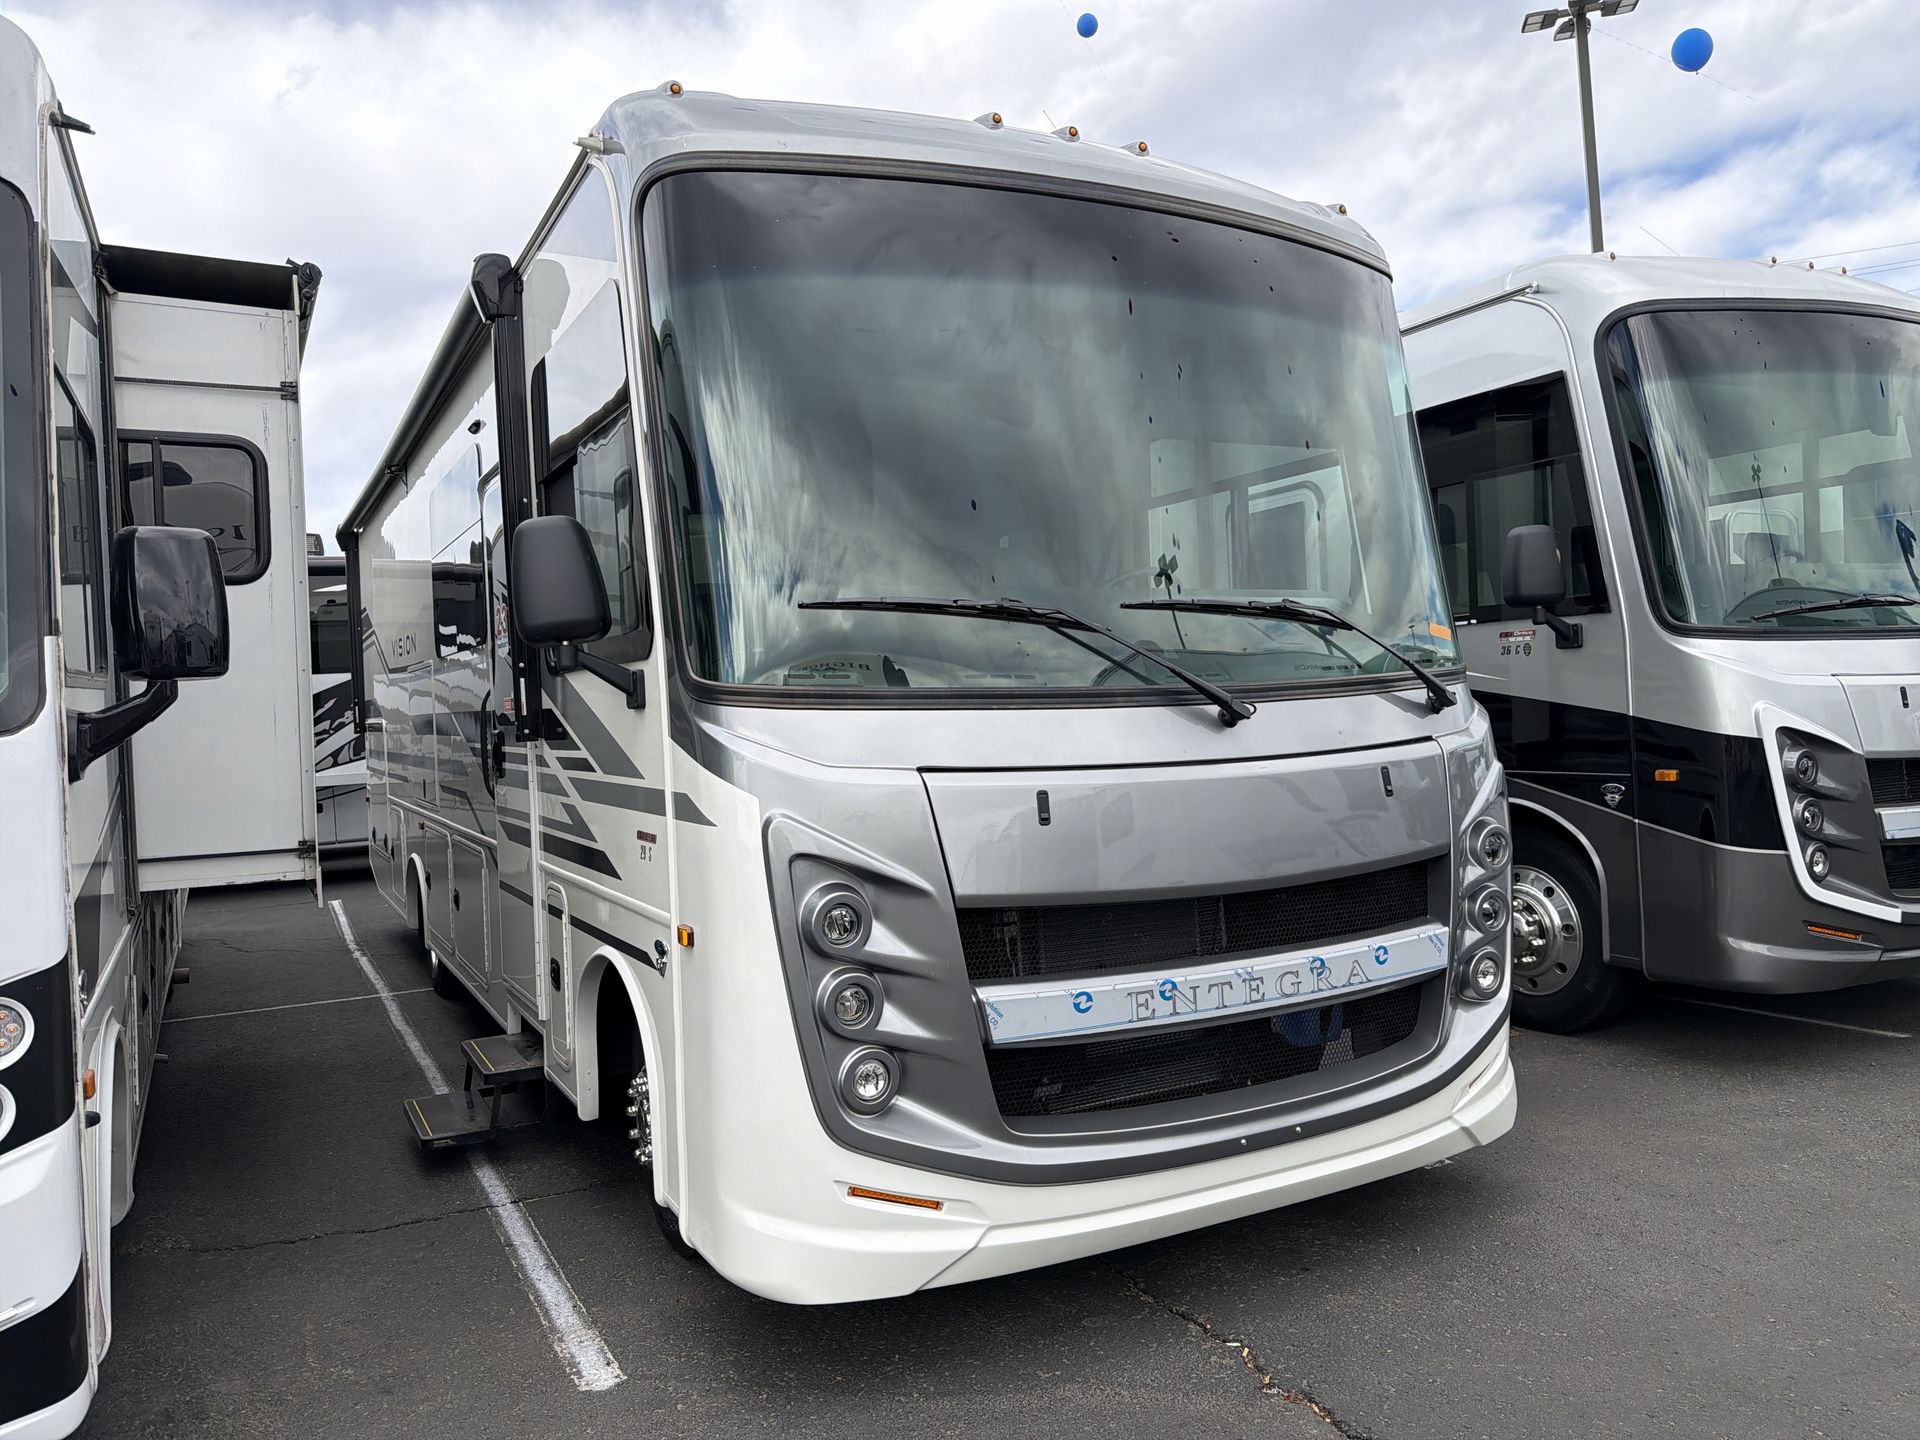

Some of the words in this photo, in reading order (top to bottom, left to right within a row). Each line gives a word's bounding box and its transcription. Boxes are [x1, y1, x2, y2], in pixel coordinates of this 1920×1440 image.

[391, 632, 417, 657] VISION
[1500, 645, 1512, 656] 36
[1127, 959, 1373, 1023] ENTEGRA
